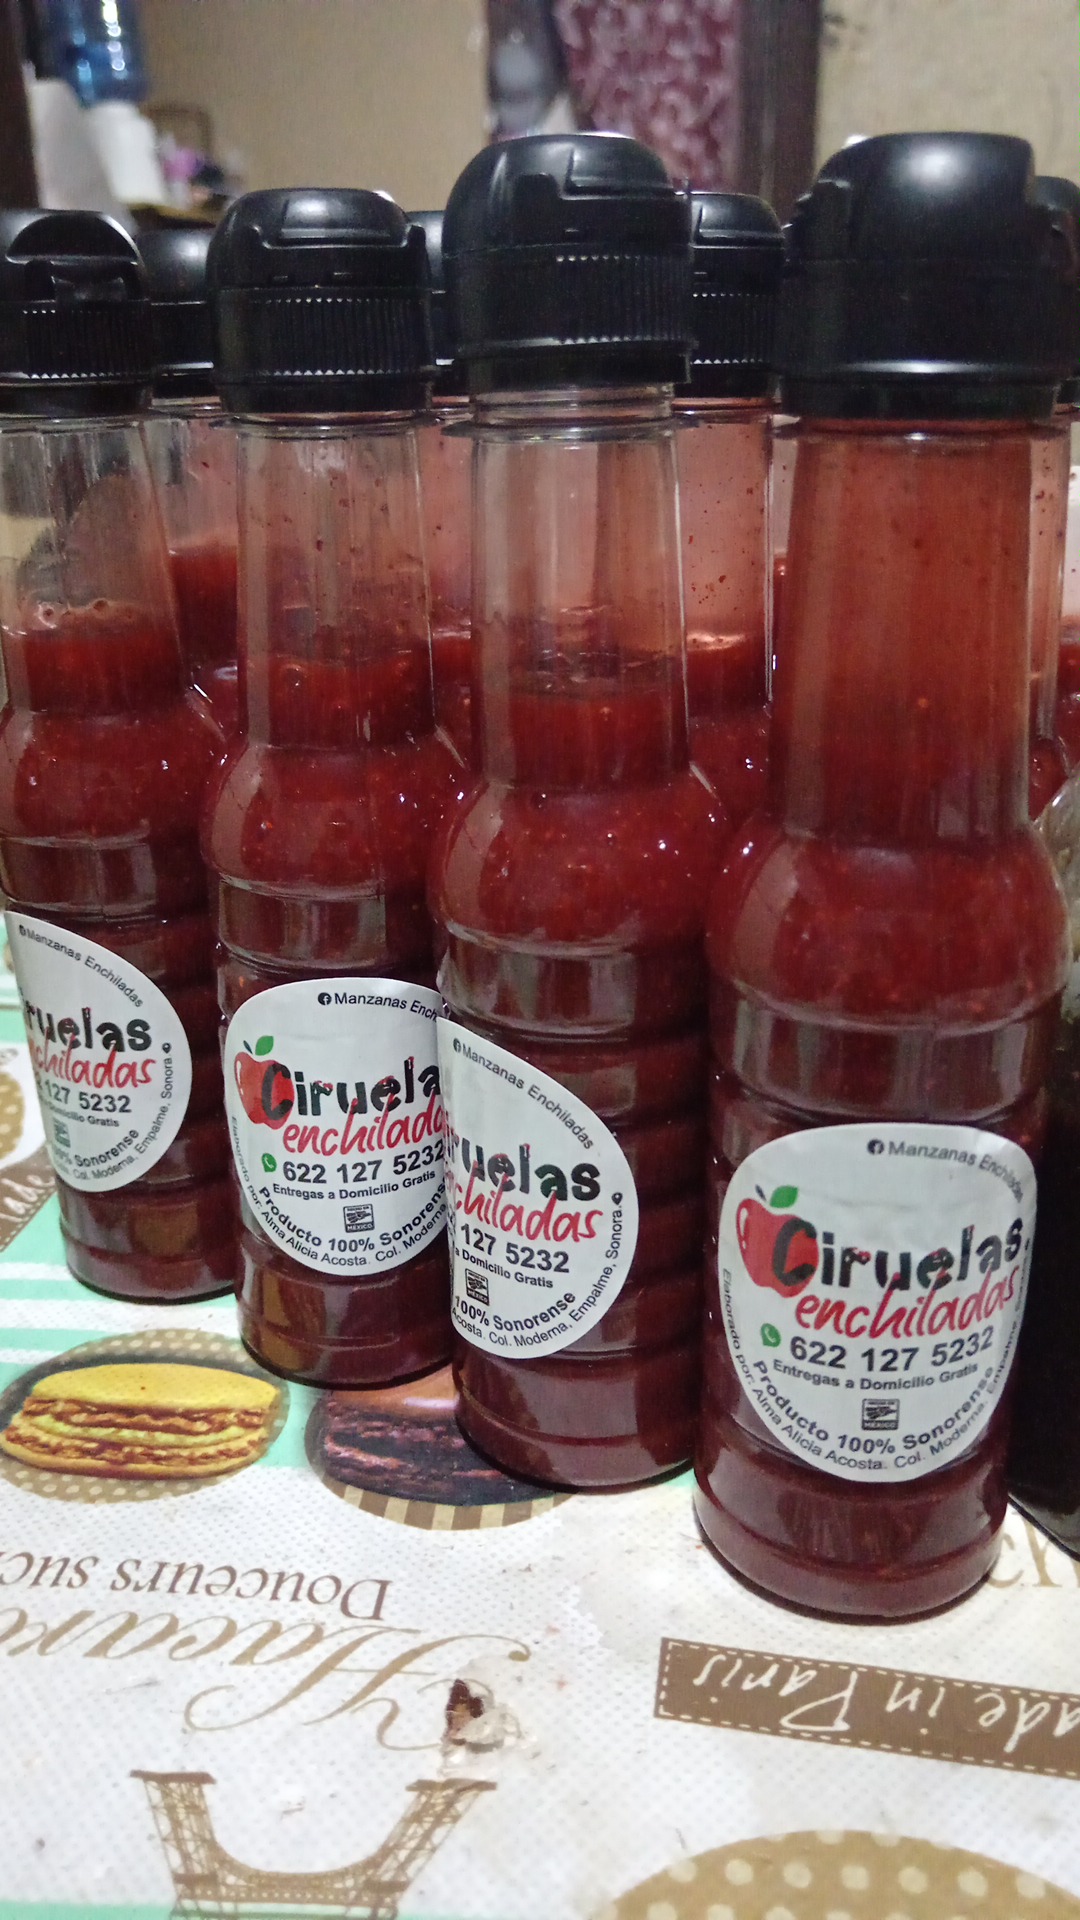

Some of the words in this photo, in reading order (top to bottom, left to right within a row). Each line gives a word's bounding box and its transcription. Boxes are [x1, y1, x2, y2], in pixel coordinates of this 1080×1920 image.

[27, 928, 82, 961] Manzanas
[84, 956, 144, 1008] Enchiladas
[24, 1000, 152, 1052] ruelas
[335, 992, 408, 1010] Manzanas
[410, 999, 437, 1022] Ench
[79, 1091, 132, 1113] 5232
[261, 1056, 440, 1121] Ciruela
[463, 1043, 525, 1089] Manzanas
[528, 1084, 594, 1149] Enchiladas
[87, 1115, 120, 1128] Gratis
[74, 1129, 140, 1168] Sonorense
[283, 1160, 327, 1184] 622
[337, 1159, 383, 1184] 127
[393, 1138, 445, 1175] 5232
[447, 1128, 600, 1201] ruelas
[888, 1140, 977, 1167] Manzanas
[272, 1183, 325, 1200] Entregas
[328, 1192, 335, 1200] a
[339, 1183, 399, 1200] Domicilio
[402, 1169, 436, 1188] Gratis
[259, 1186, 322, 1246] Producto
[328, 1237, 375, 1253] 100%
[379, 1178, 446, 1247] Sonorens
[261, 1210, 286, 1240] Alma
[286, 1237, 319, 1260] Alicia
[375, 1246, 401, 1263] Col.
[461, 1223, 497, 1256] 127
[506, 1242, 570, 1273] 5232
[462, 1249, 511, 1279] Domicilio
[514, 1271, 554, 1289] Gratis
[772, 1217, 1024, 1291] Ciruelas
[455, 1295, 490, 1327] 100%
[493, 1291, 577, 1332] Sonorense
[489, 1331, 512, 1347] Col.
[514, 1324, 573, 1347] Moderna,
[568, 1264, 618, 1322] Empalme,
[795, 1265, 1020, 1339] enchiladas
[723, 1268, 741, 1350] Elaborado
[752, 1386, 783, 1427] Alma
[782, 1423, 823, 1457] Alicia
[894, 1453, 926, 1469] Col.
[772, 1359, 839, 1388] Entregas
[845, 1379, 855, 1390] a
[860, 1375, 935, 1391] Domicilio
[939, 1362, 979, 1383] Gratis
[790, 1336, 847, 1369] 622
[861, 1347, 920, 1373] 127
[931, 1325, 995, 1367] 5232
[753, 1360, 829, 1442] Producto
[838, 1434, 896, 1455] 100%
[902, 1366, 995, 1450] Sonorense
[0, 1551, 100, 1590] suc
[110, 1556, 394, 1622] Douceurs
[692, 1653, 859, 1733] Paris
[886, 1680, 945, 1735] in
[979, 1692, 1080, 1754] ade
